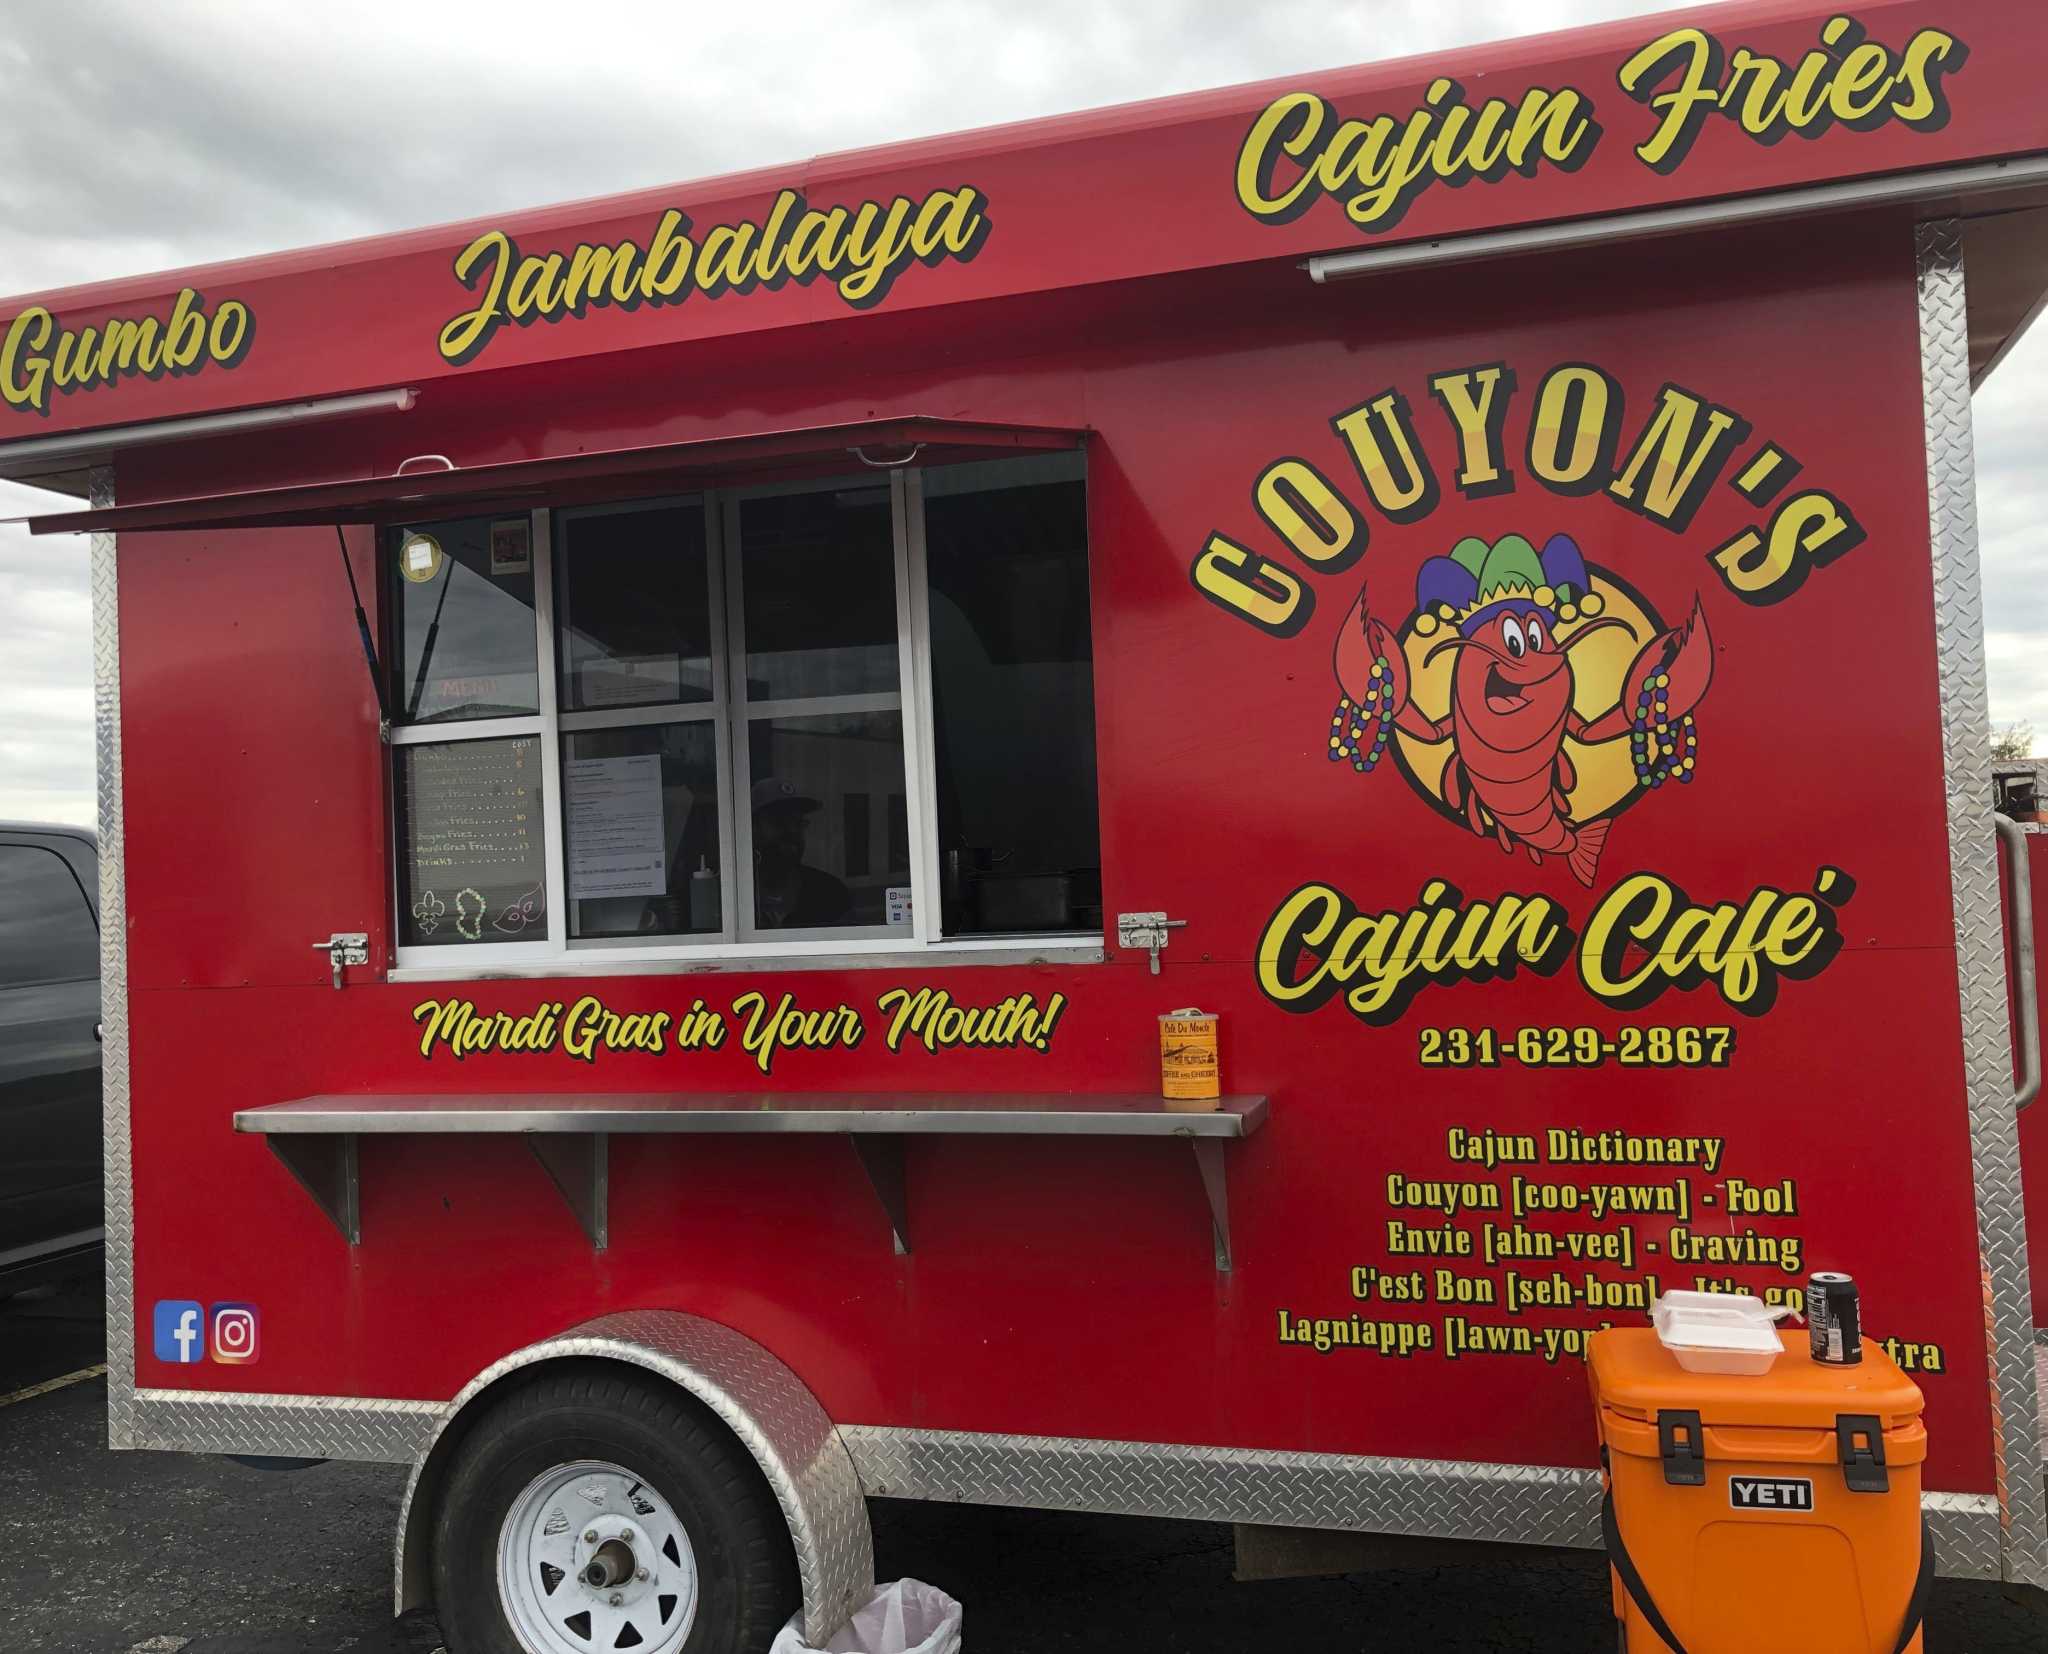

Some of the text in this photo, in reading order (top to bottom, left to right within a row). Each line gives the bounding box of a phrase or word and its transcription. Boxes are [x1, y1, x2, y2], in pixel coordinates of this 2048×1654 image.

[1235, 17, 1954, 224] Cajun Fries
[438, 187, 981, 358] Jambalaya
[0, 287, 250, 411] Gumbo
[1194, 366, 1850, 626] COUYON'S
[1257, 879, 1562, 1014] Cajun
[412, 986, 1069, 1072] Mardi Gras in Your Mouth!
[1419, 1025, 1732, 1065] 231-629-2867
[1447, 1127, 1722, 1170] Cajun Dictionary
[1386, 1173, 1500, 1216] Couyon
[1511, 1175, 1689, 1220] [coo-yawn]
[1726, 1178, 1796, 1214] Fool
[1386, 1220, 1471, 1255] Envie
[1483, 1222, 1634, 1268] [ahn-vee]
[1668, 1227, 1802, 1270] Craving
[1350, 1266, 1425, 1301] C'est
[1434, 1268, 1495, 1303] Bon
[1506, 1271, 1658, 1318] [seh-bon]
[1277, 1310, 1433, 1357] Lagniappe
[1733, 1482, 1807, 1506] YETI
